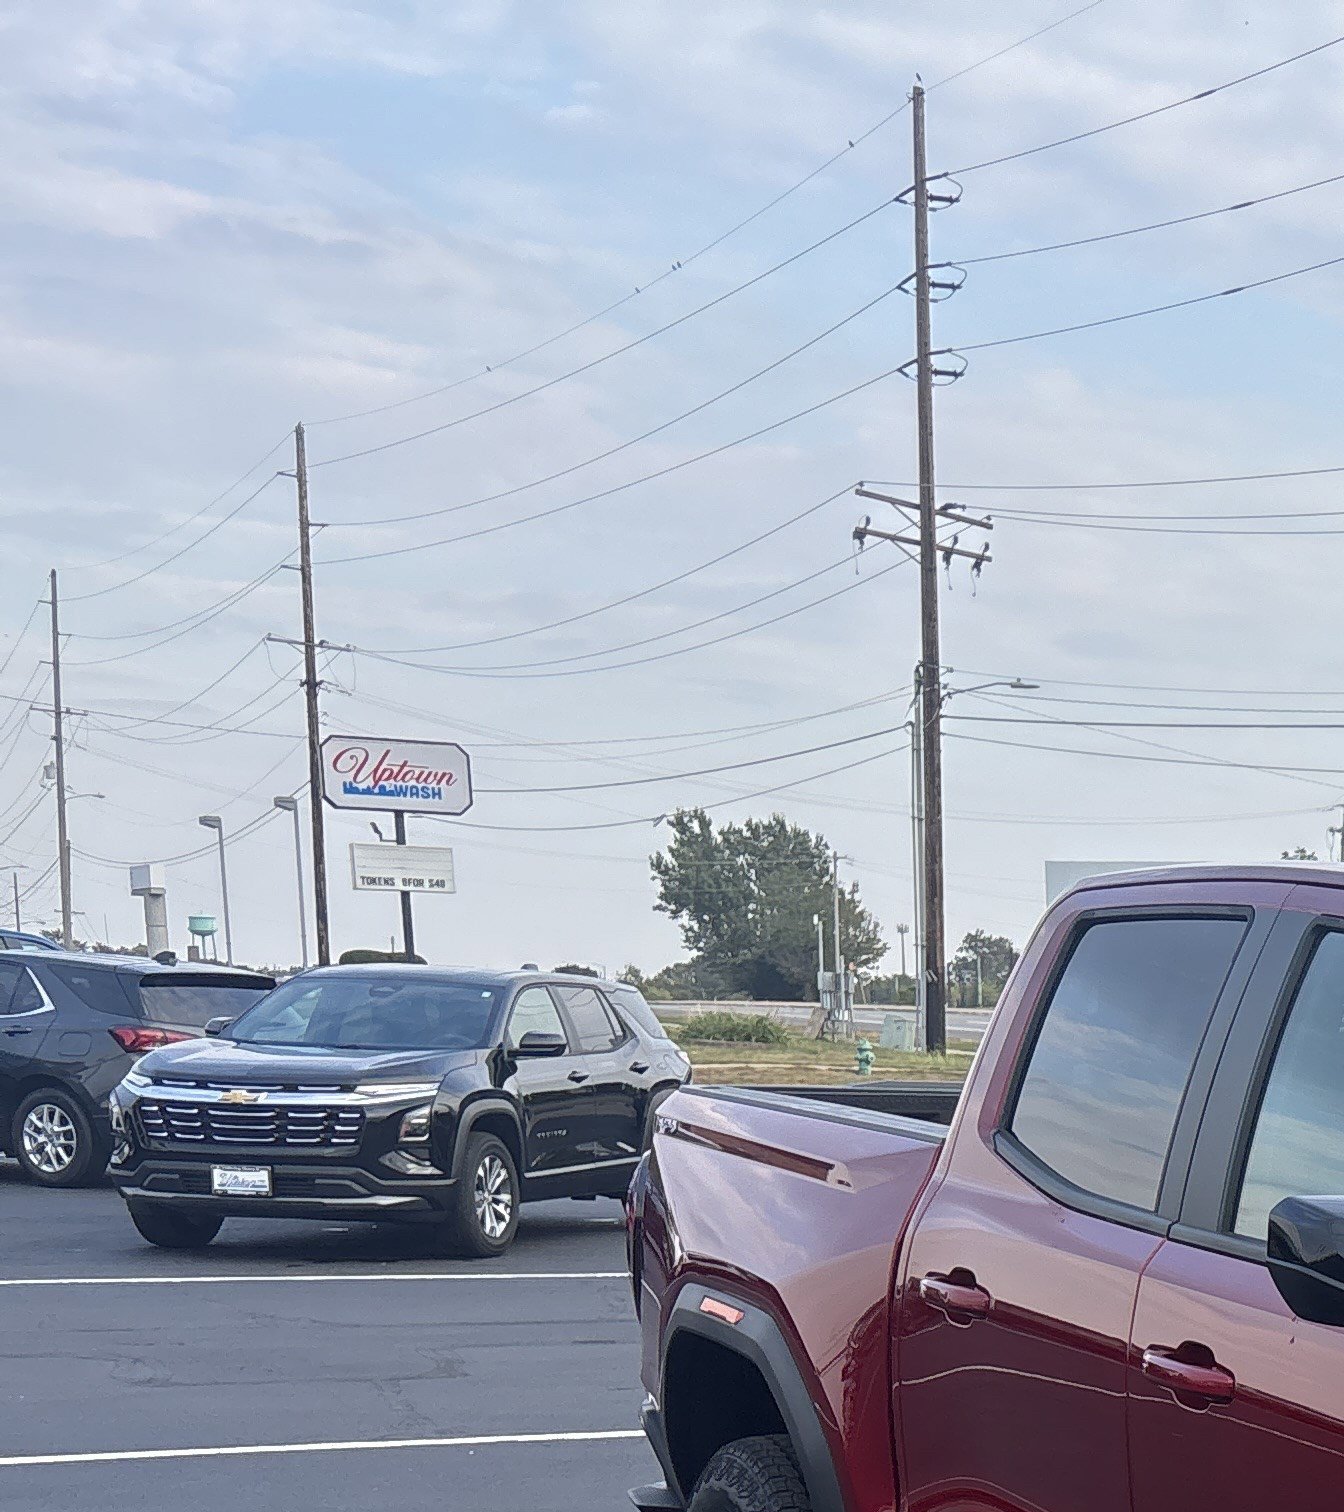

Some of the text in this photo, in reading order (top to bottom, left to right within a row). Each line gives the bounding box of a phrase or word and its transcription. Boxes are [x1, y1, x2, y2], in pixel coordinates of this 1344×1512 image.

[332, 746, 458, 789] Uptown
[394, 783, 443, 800] WASH
[360, 875, 396, 888] TOKENS
